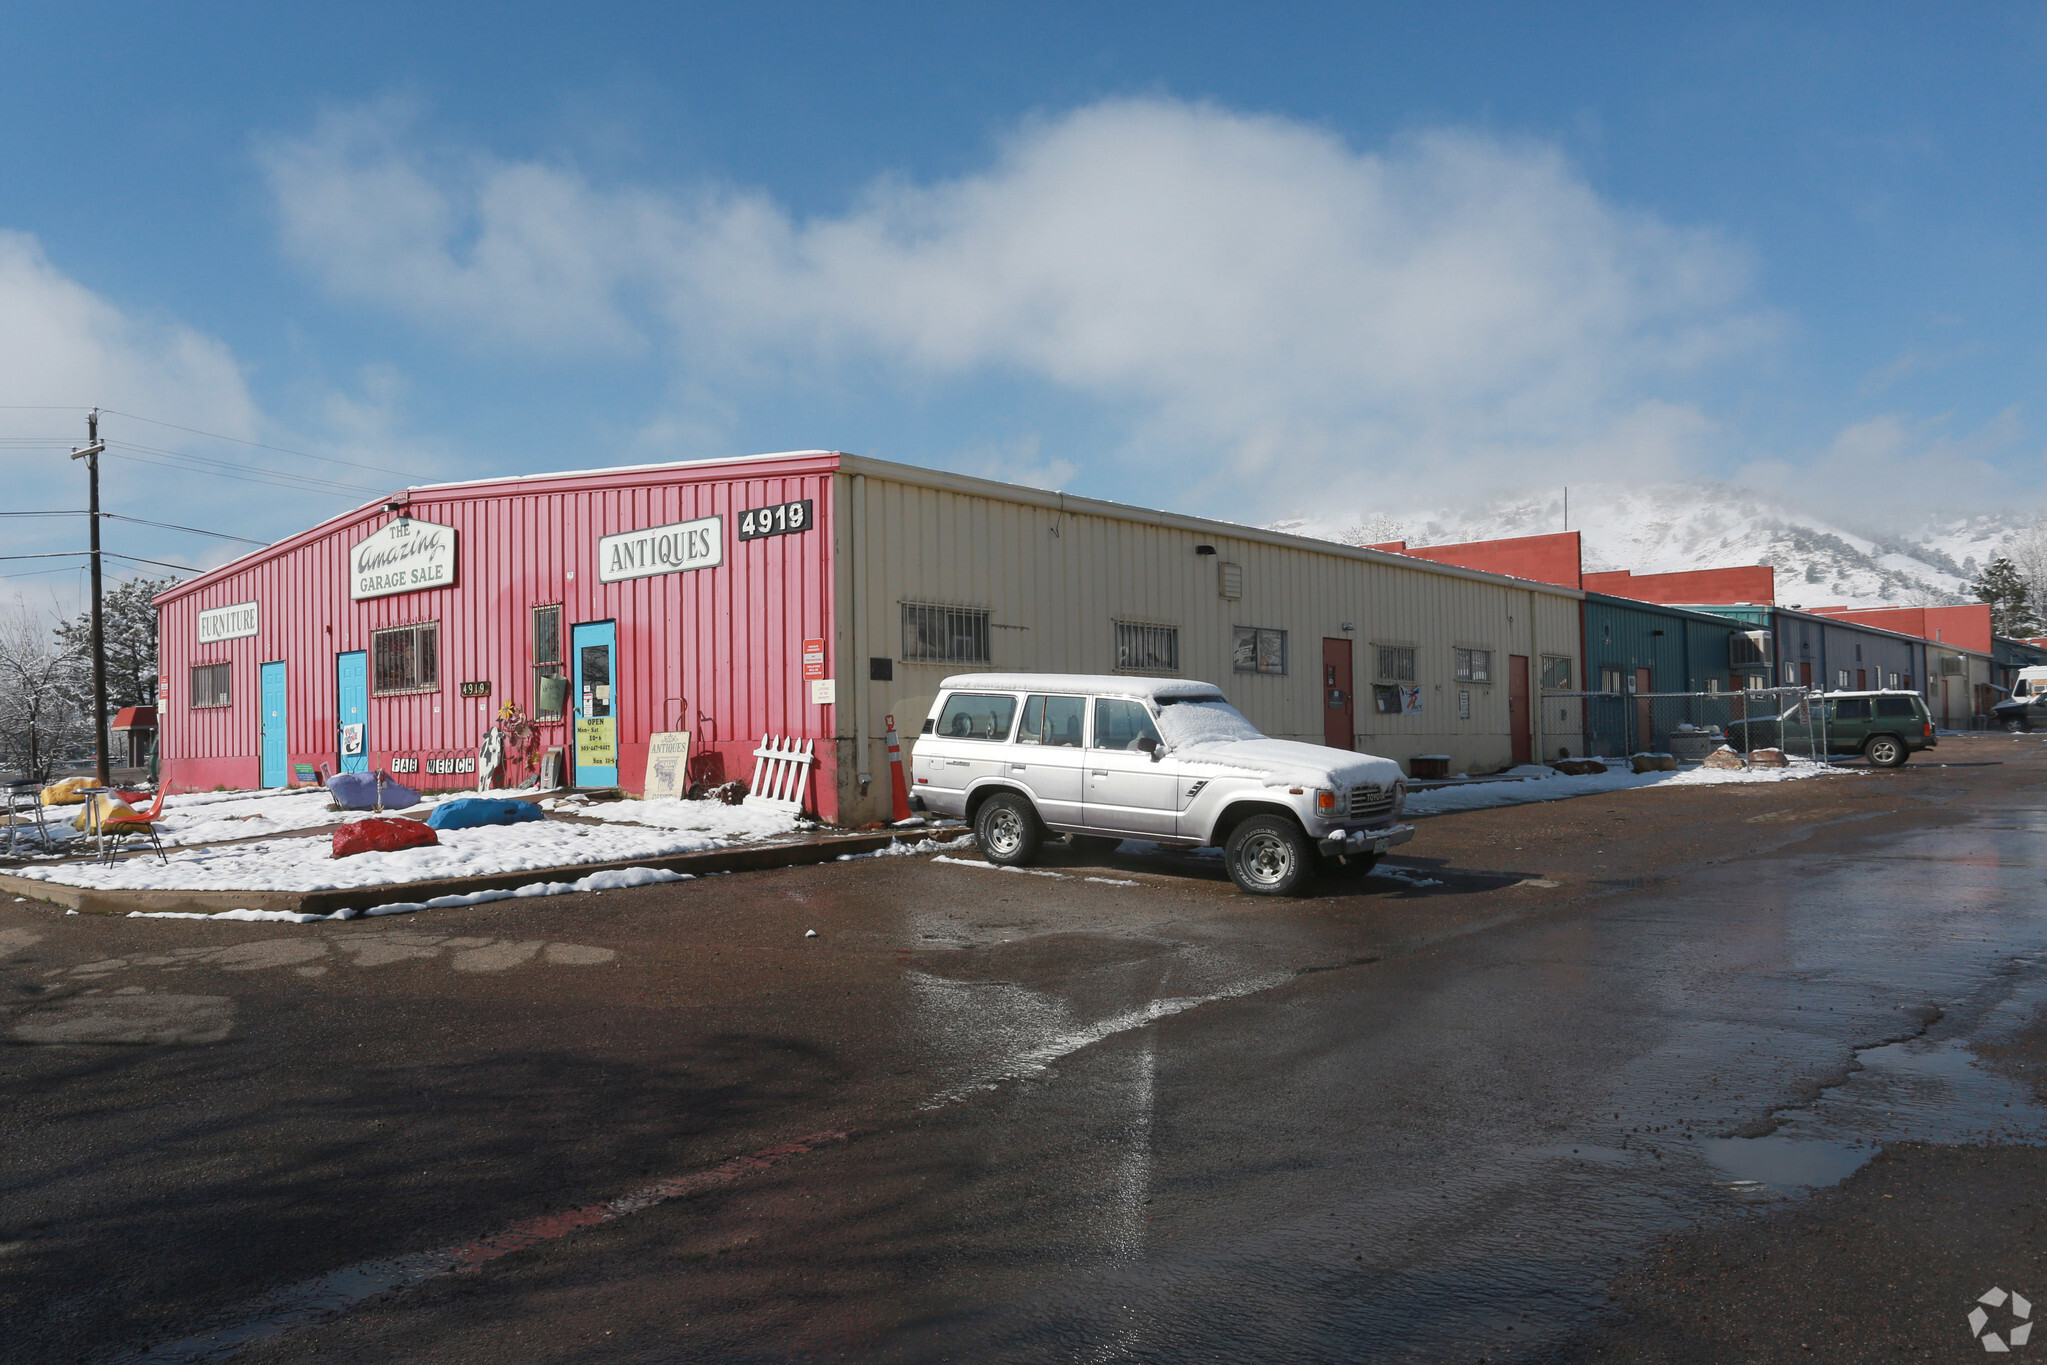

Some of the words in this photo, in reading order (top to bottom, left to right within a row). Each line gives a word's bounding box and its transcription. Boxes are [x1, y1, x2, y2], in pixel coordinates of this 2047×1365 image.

[742, 502, 804, 535] 4919
[389, 525, 411, 539] THE
[358, 530, 445, 573] Amazing
[608, 527, 710, 573] ANTIQUES
[360, 571, 407, 592] GARAGE
[411, 564, 444, 584] SALE
[201, 608, 256, 637] FURNITURE
[462, 683, 485, 695] 4919
[587, 718, 605, 726] OPEN
[651, 743, 686, 753] ANTIQUES
[394, 757, 418, 772] FAB
[426, 757, 475, 773] MERCH
